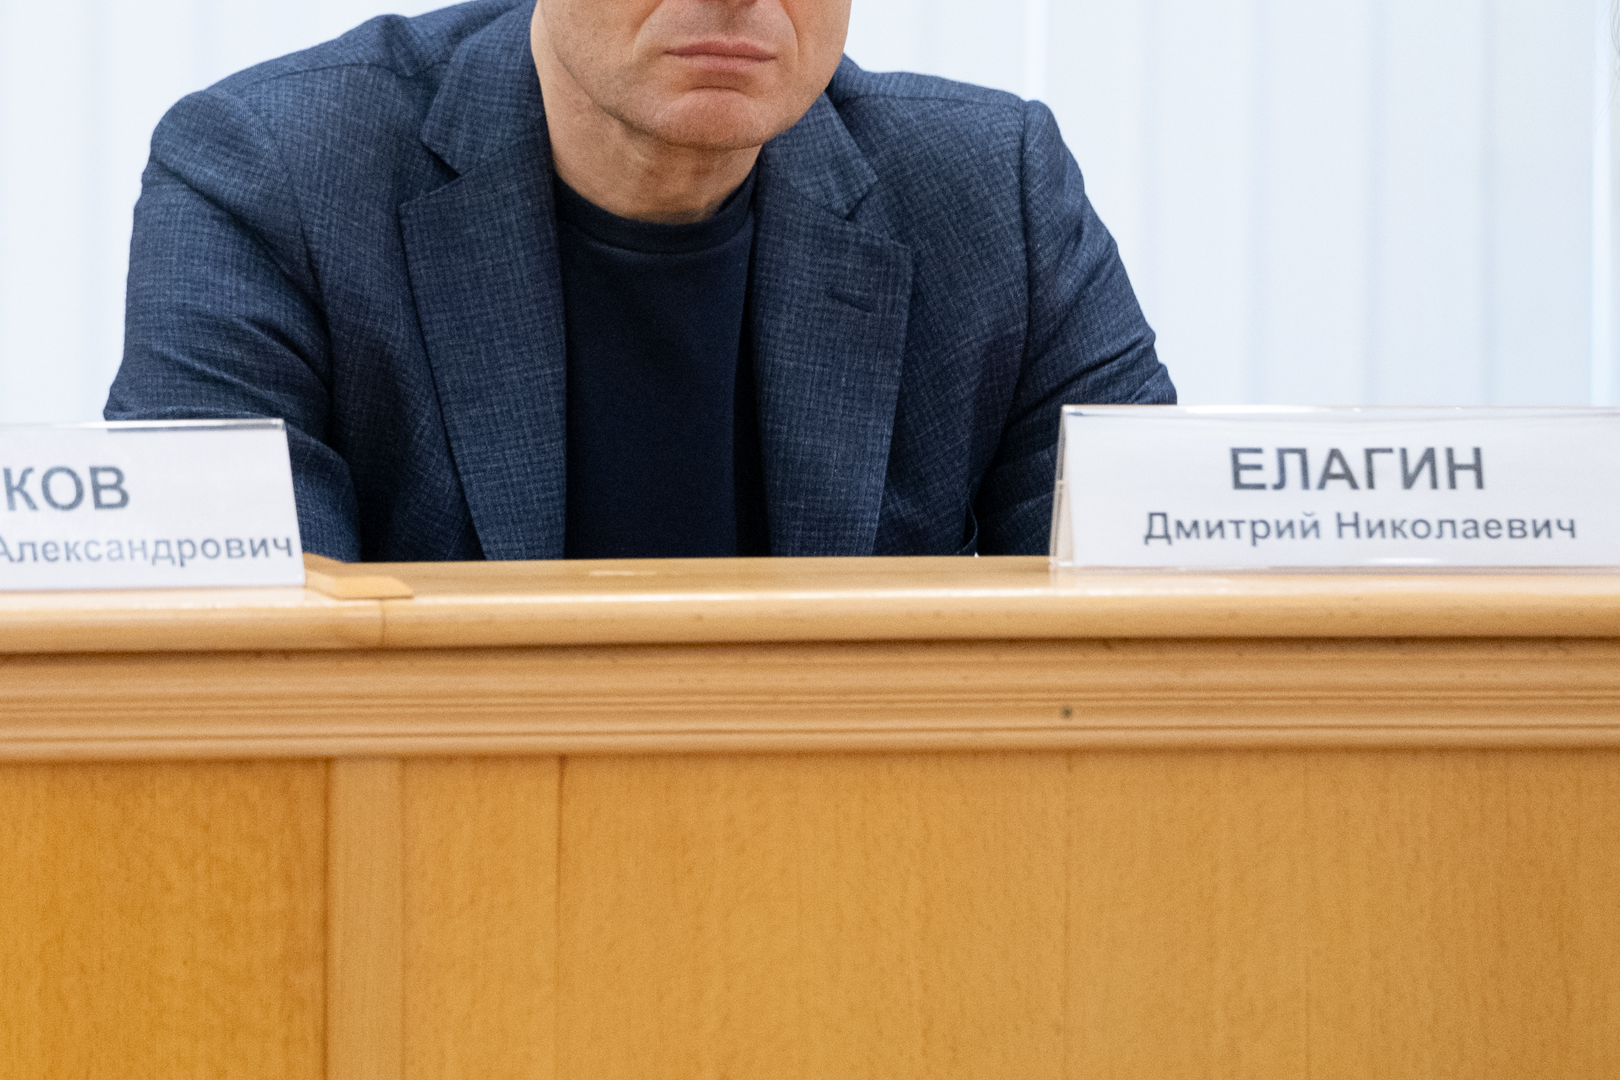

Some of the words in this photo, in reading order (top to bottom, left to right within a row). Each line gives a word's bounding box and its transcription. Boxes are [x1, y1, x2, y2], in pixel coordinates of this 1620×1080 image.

[1230, 446, 1485, 490] ЕЛАГИН
[1144, 511, 1320, 547] Дмитрий
[1336, 512, 1577, 540] Николаевич
